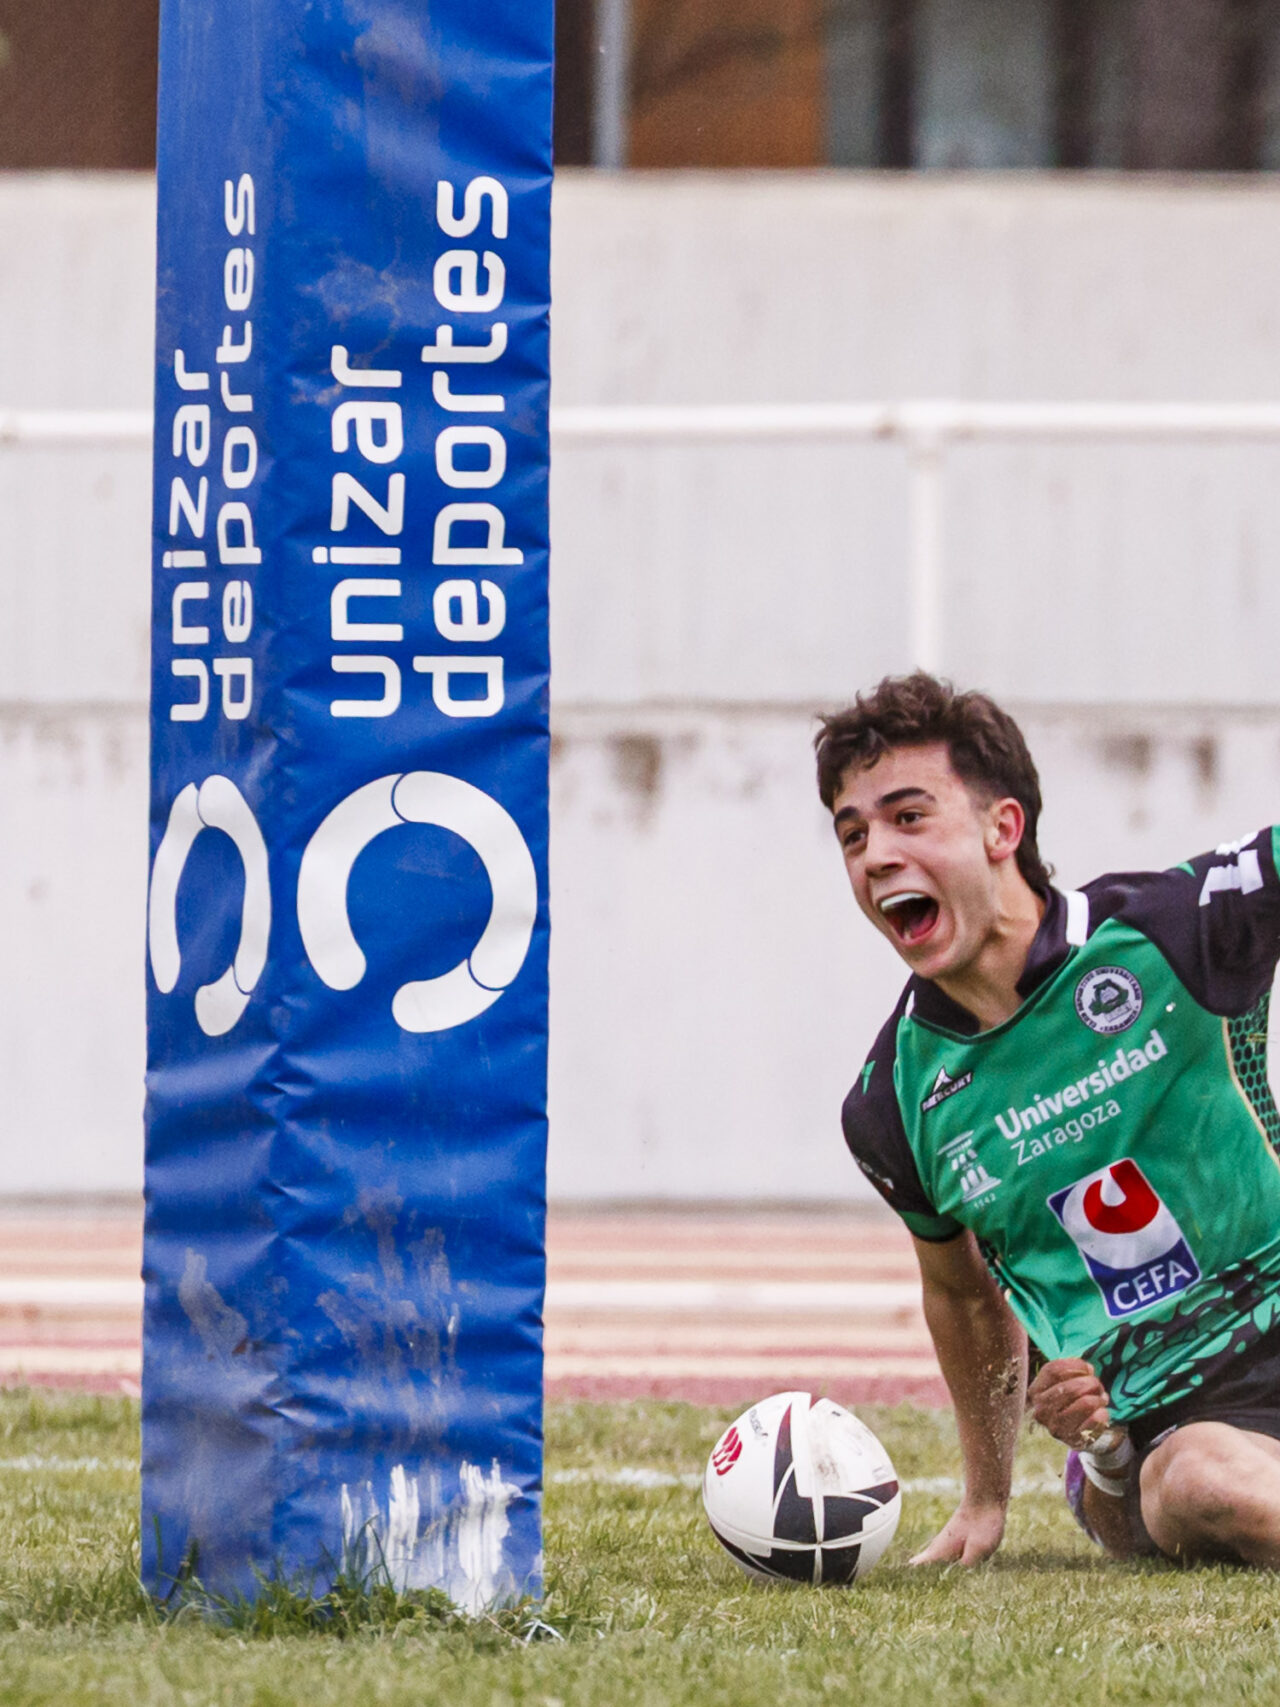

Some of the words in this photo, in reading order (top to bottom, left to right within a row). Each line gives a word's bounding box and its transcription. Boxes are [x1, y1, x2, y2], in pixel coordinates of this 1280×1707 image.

[163, 349, 211, 722] unizar
[213, 173, 262, 721] deportes
[312, 345, 405, 719] unizar
[413, 175, 524, 718] deportes
[994, 1029, 1168, 1140] Universidad
[1010, 1099, 1122, 1166] Zaragoza
[1113, 1260, 1192, 1310] CEFA
